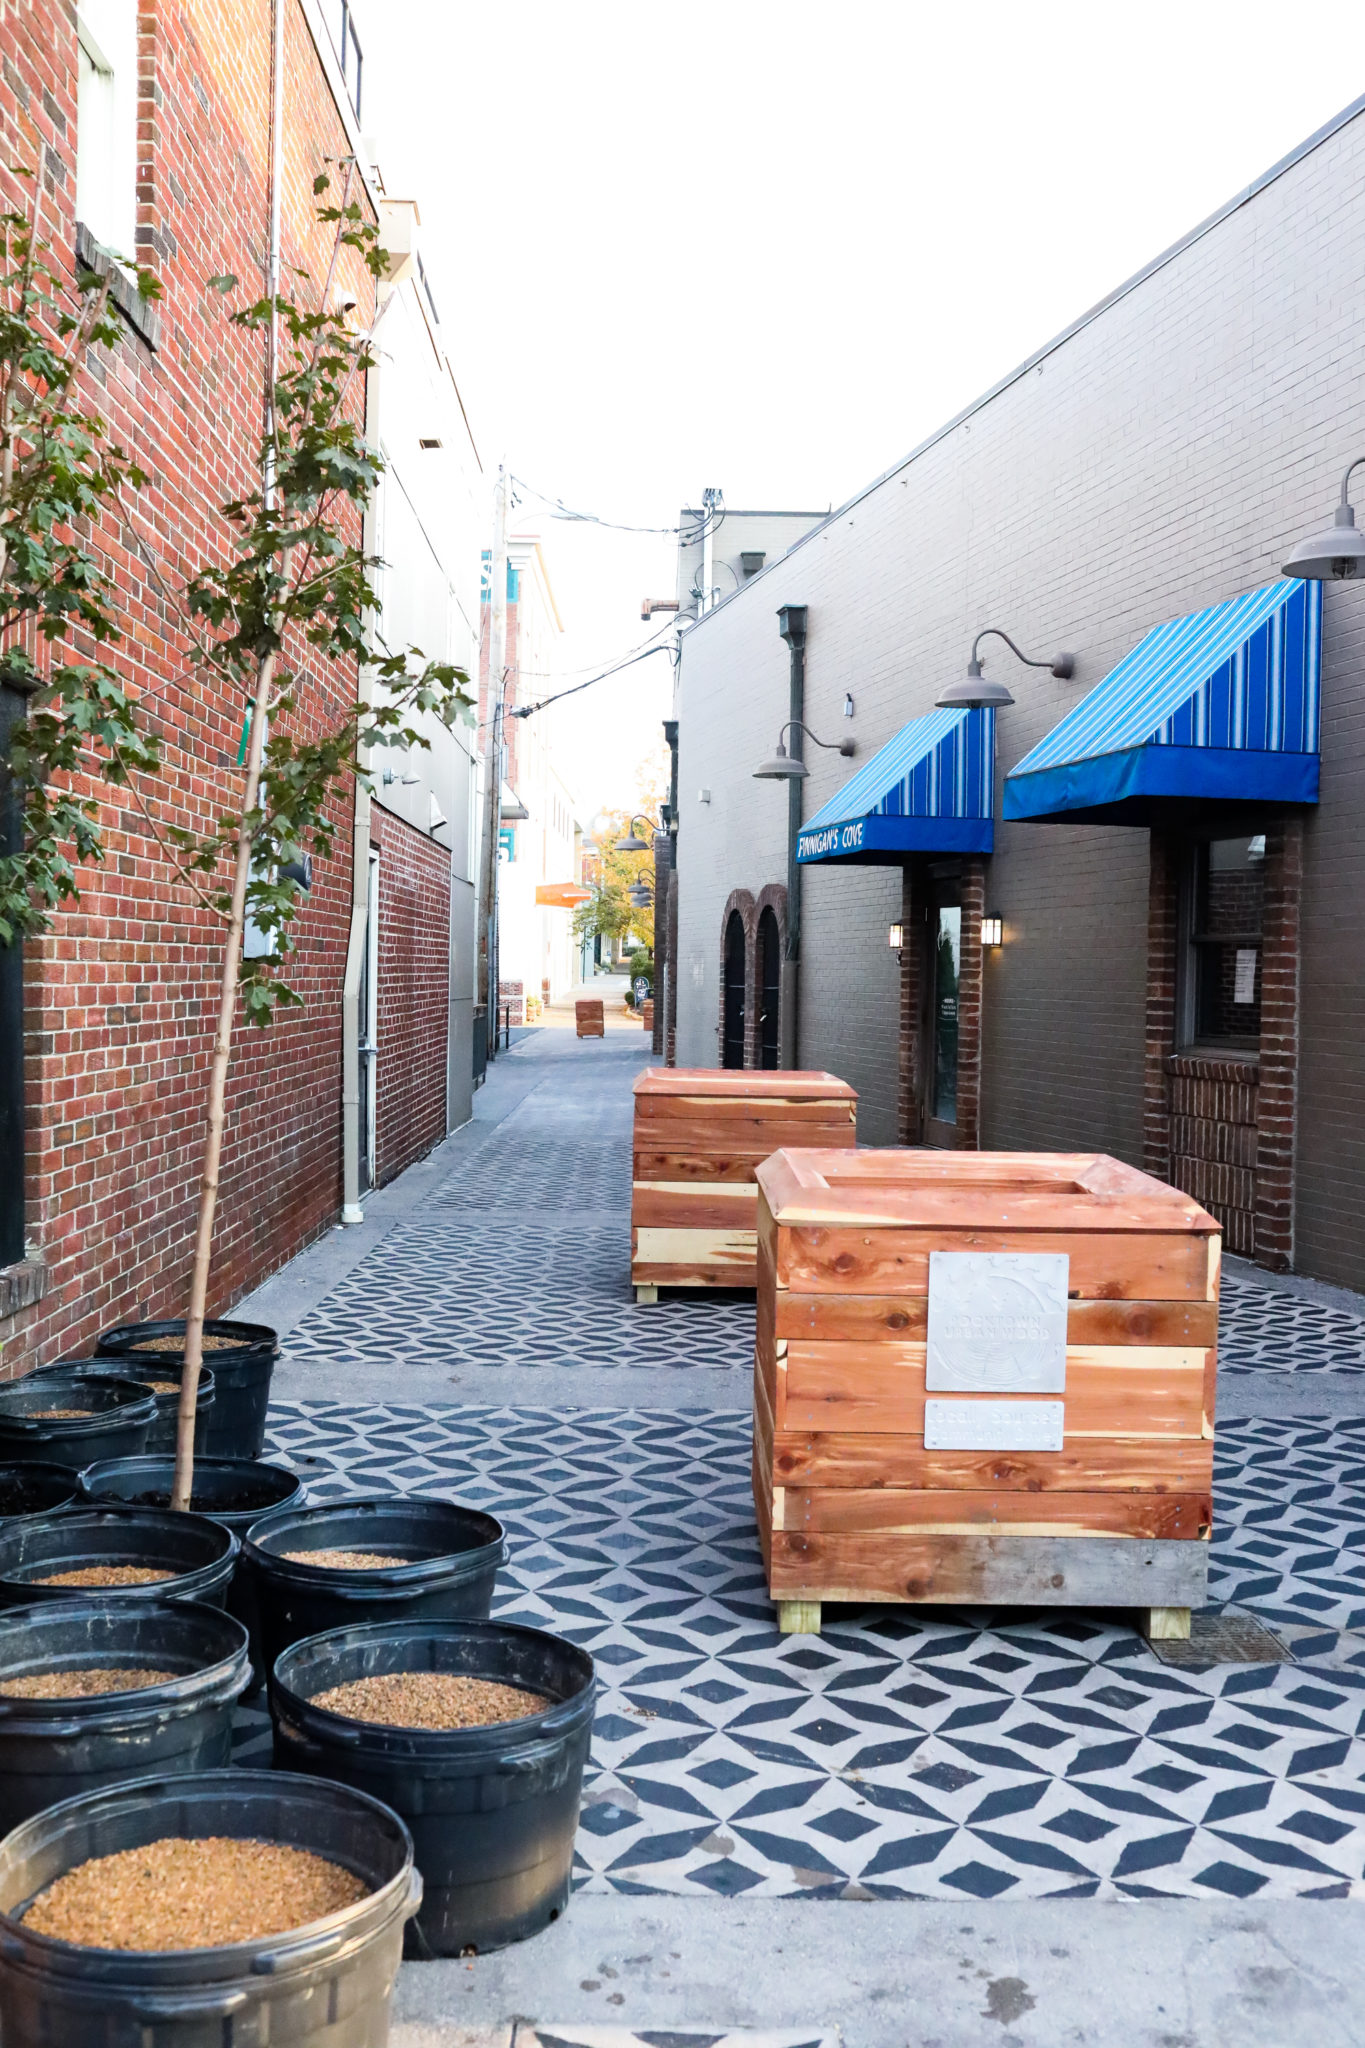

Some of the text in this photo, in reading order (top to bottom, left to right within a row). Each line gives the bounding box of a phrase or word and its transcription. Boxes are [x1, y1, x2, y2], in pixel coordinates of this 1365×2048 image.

[797, 822, 864, 858] FINNIGAN'S COVE
[944, 1327, 1052, 1340] URBAN WOOD
